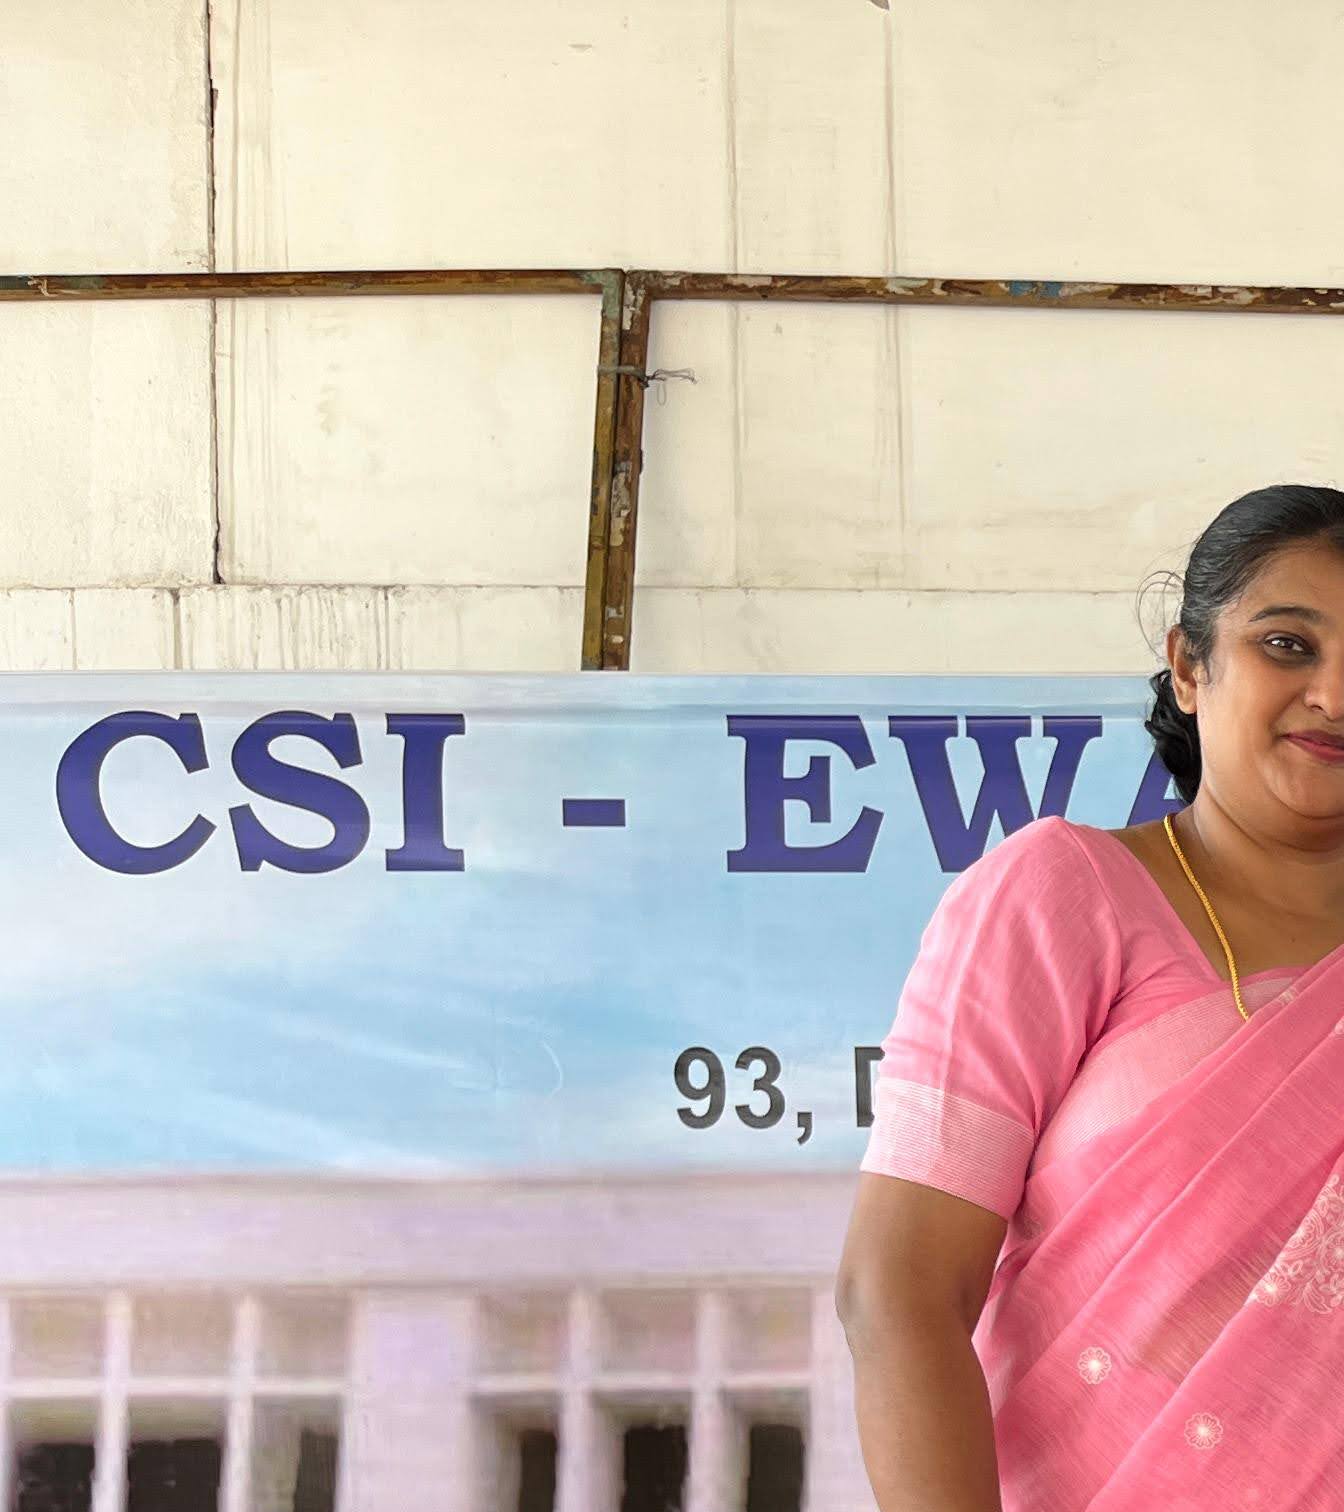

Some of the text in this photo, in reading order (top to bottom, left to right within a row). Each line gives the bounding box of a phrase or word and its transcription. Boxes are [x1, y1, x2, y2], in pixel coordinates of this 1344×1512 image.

[55, 710, 467, 875] CSI
[562, 797, 626, 827] -
[674, 1046, 812, 1145] 93,
